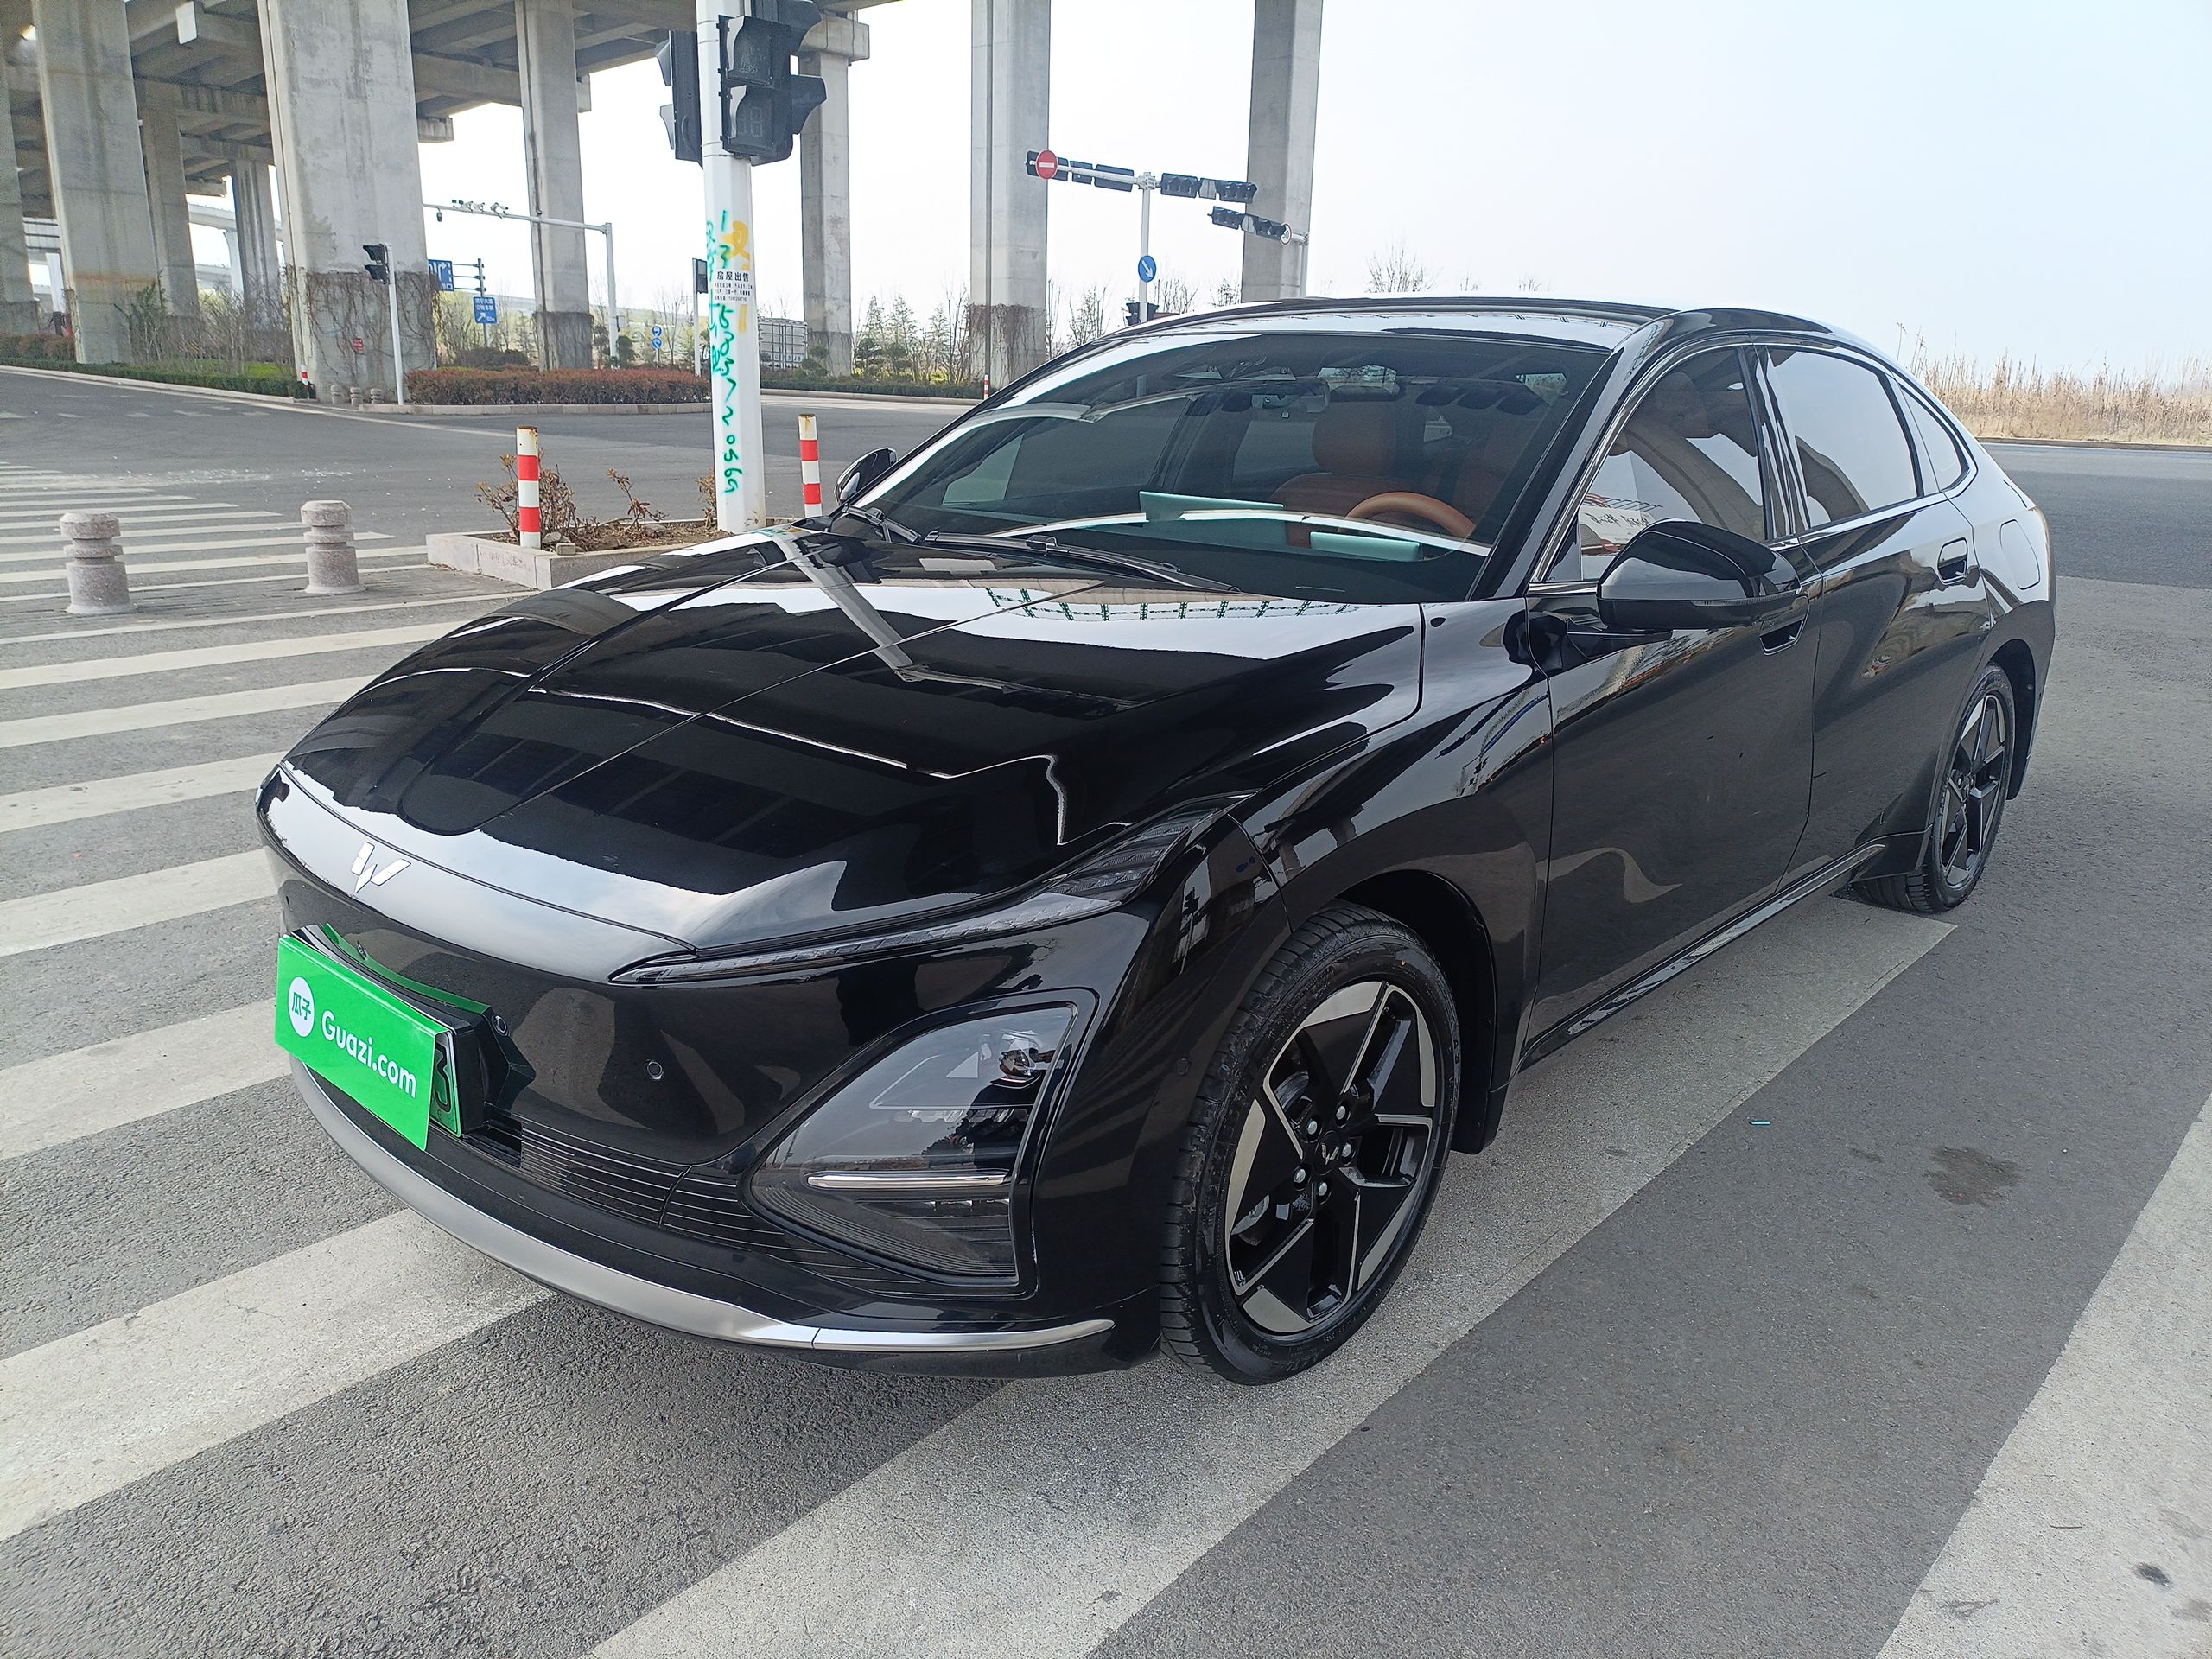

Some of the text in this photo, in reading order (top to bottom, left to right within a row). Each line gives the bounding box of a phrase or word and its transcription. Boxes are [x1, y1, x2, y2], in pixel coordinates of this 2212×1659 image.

[716, 270, 750, 283] 房屋出售
[291, 990, 312, 1021] 瓜子
[321, 1009, 417, 1099] Guazi.com
